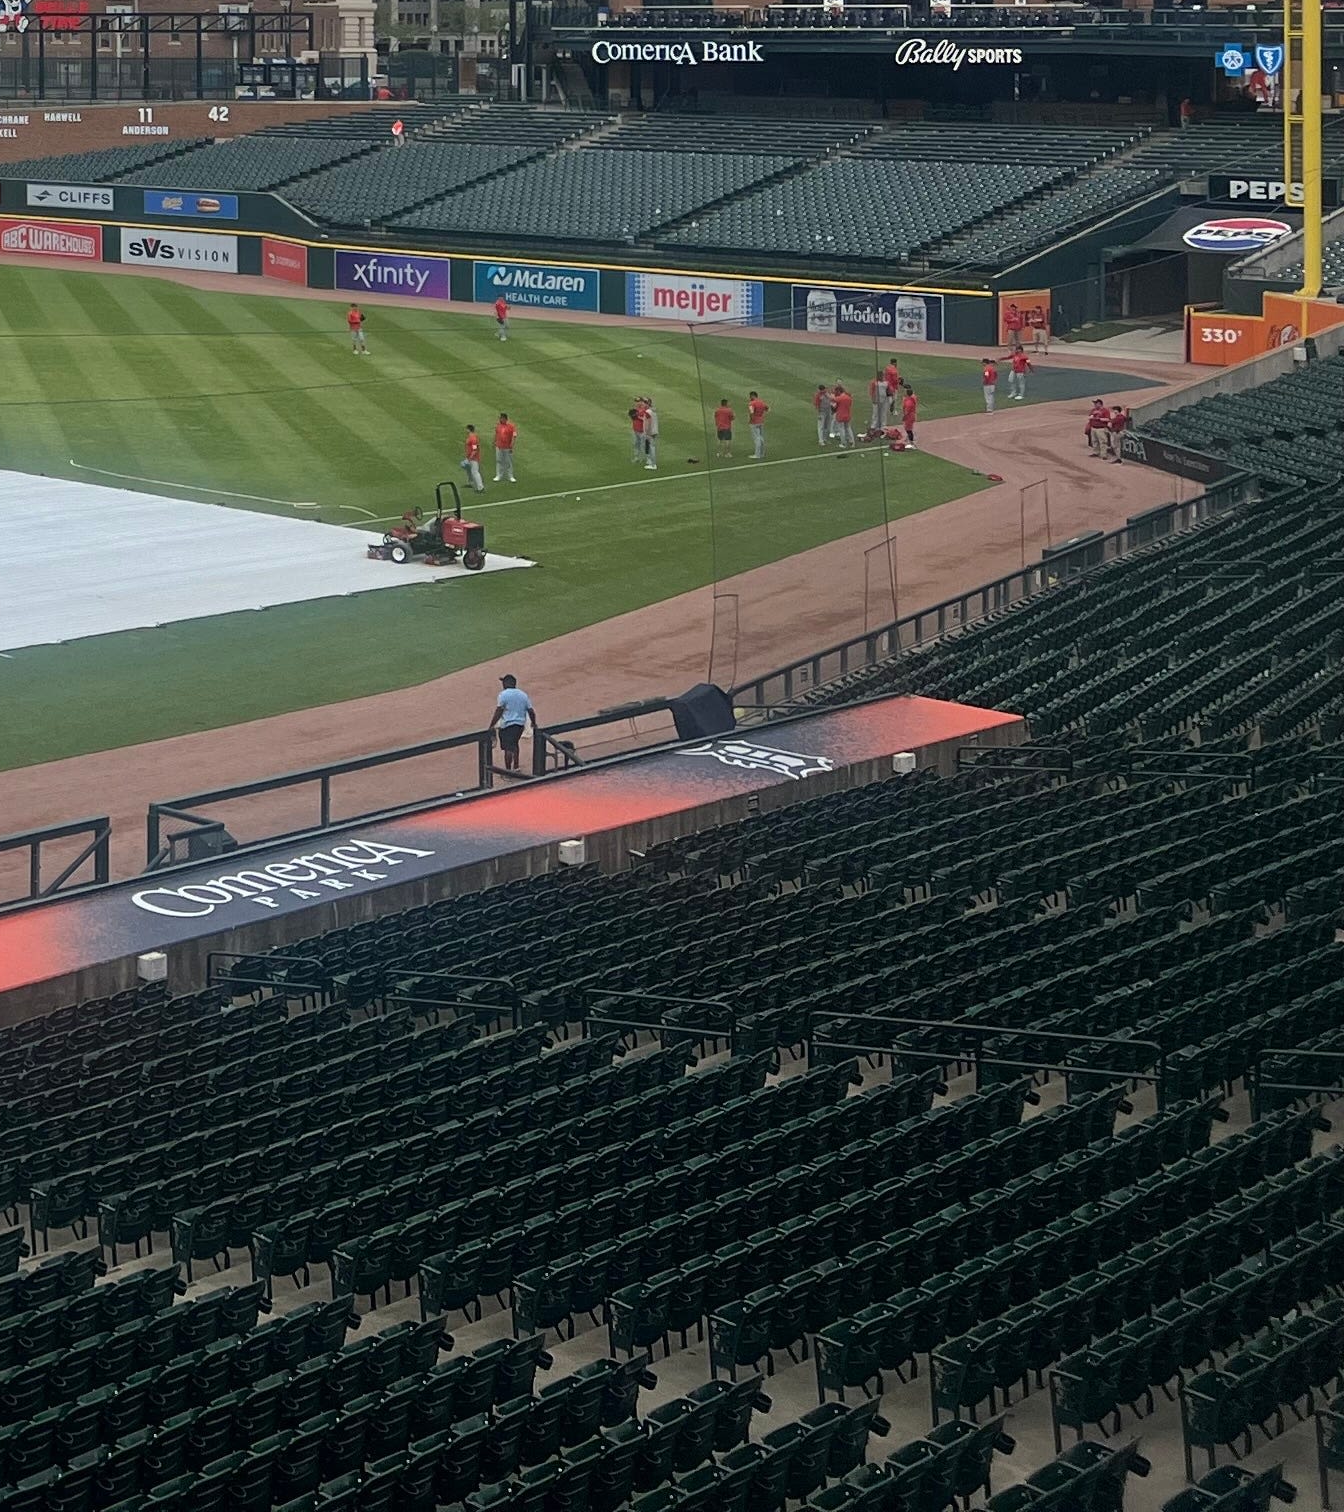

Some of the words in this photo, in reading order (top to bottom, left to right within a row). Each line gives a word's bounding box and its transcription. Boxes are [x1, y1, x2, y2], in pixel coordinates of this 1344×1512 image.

[702, 41, 764, 63] Bank
[895, 38, 967, 71] Bally
[967, 47, 1023, 64] SPORTS
[138, 107, 153, 123] 11
[208, 106, 230, 122] 42
[121, 125, 170, 136] ANDERSON
[58, 190, 111, 206] CLIFFS
[2, 228, 28, 249] ABC
[29, 227, 95, 255] WAREHOUSE
[178, 248, 229, 263] VISION
[353, 259, 430, 293] xfinity
[512, 269, 585, 292] McLaren
[505, 292, 539, 305] HEALTH
[540, 295, 568, 306] CARE
[653, 285, 733, 316] meijer
[840, 303, 892, 325] Modelo
[250, 868, 389, 909] PARK
